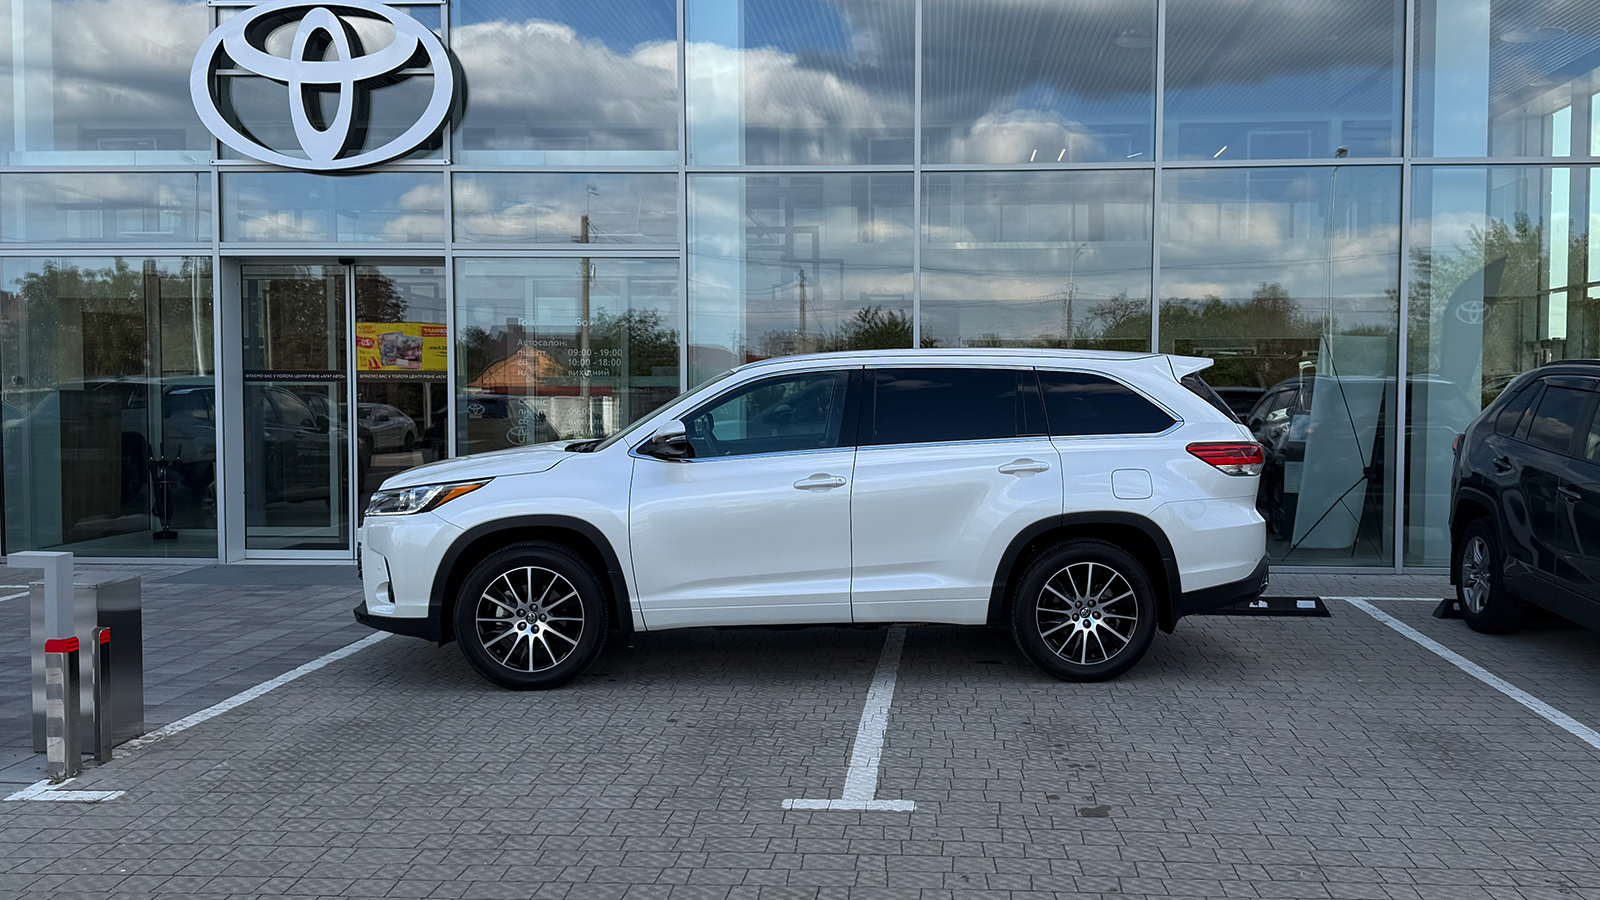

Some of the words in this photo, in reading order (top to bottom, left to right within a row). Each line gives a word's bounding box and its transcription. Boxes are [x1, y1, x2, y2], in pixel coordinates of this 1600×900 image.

[567, 348, 592, 356] 09:00
[600, 348, 623, 356] 19:00
[568, 358, 591, 366] 10:00
[598, 358, 622, 366] 18:00
[568, 368, 610, 377] вихний
